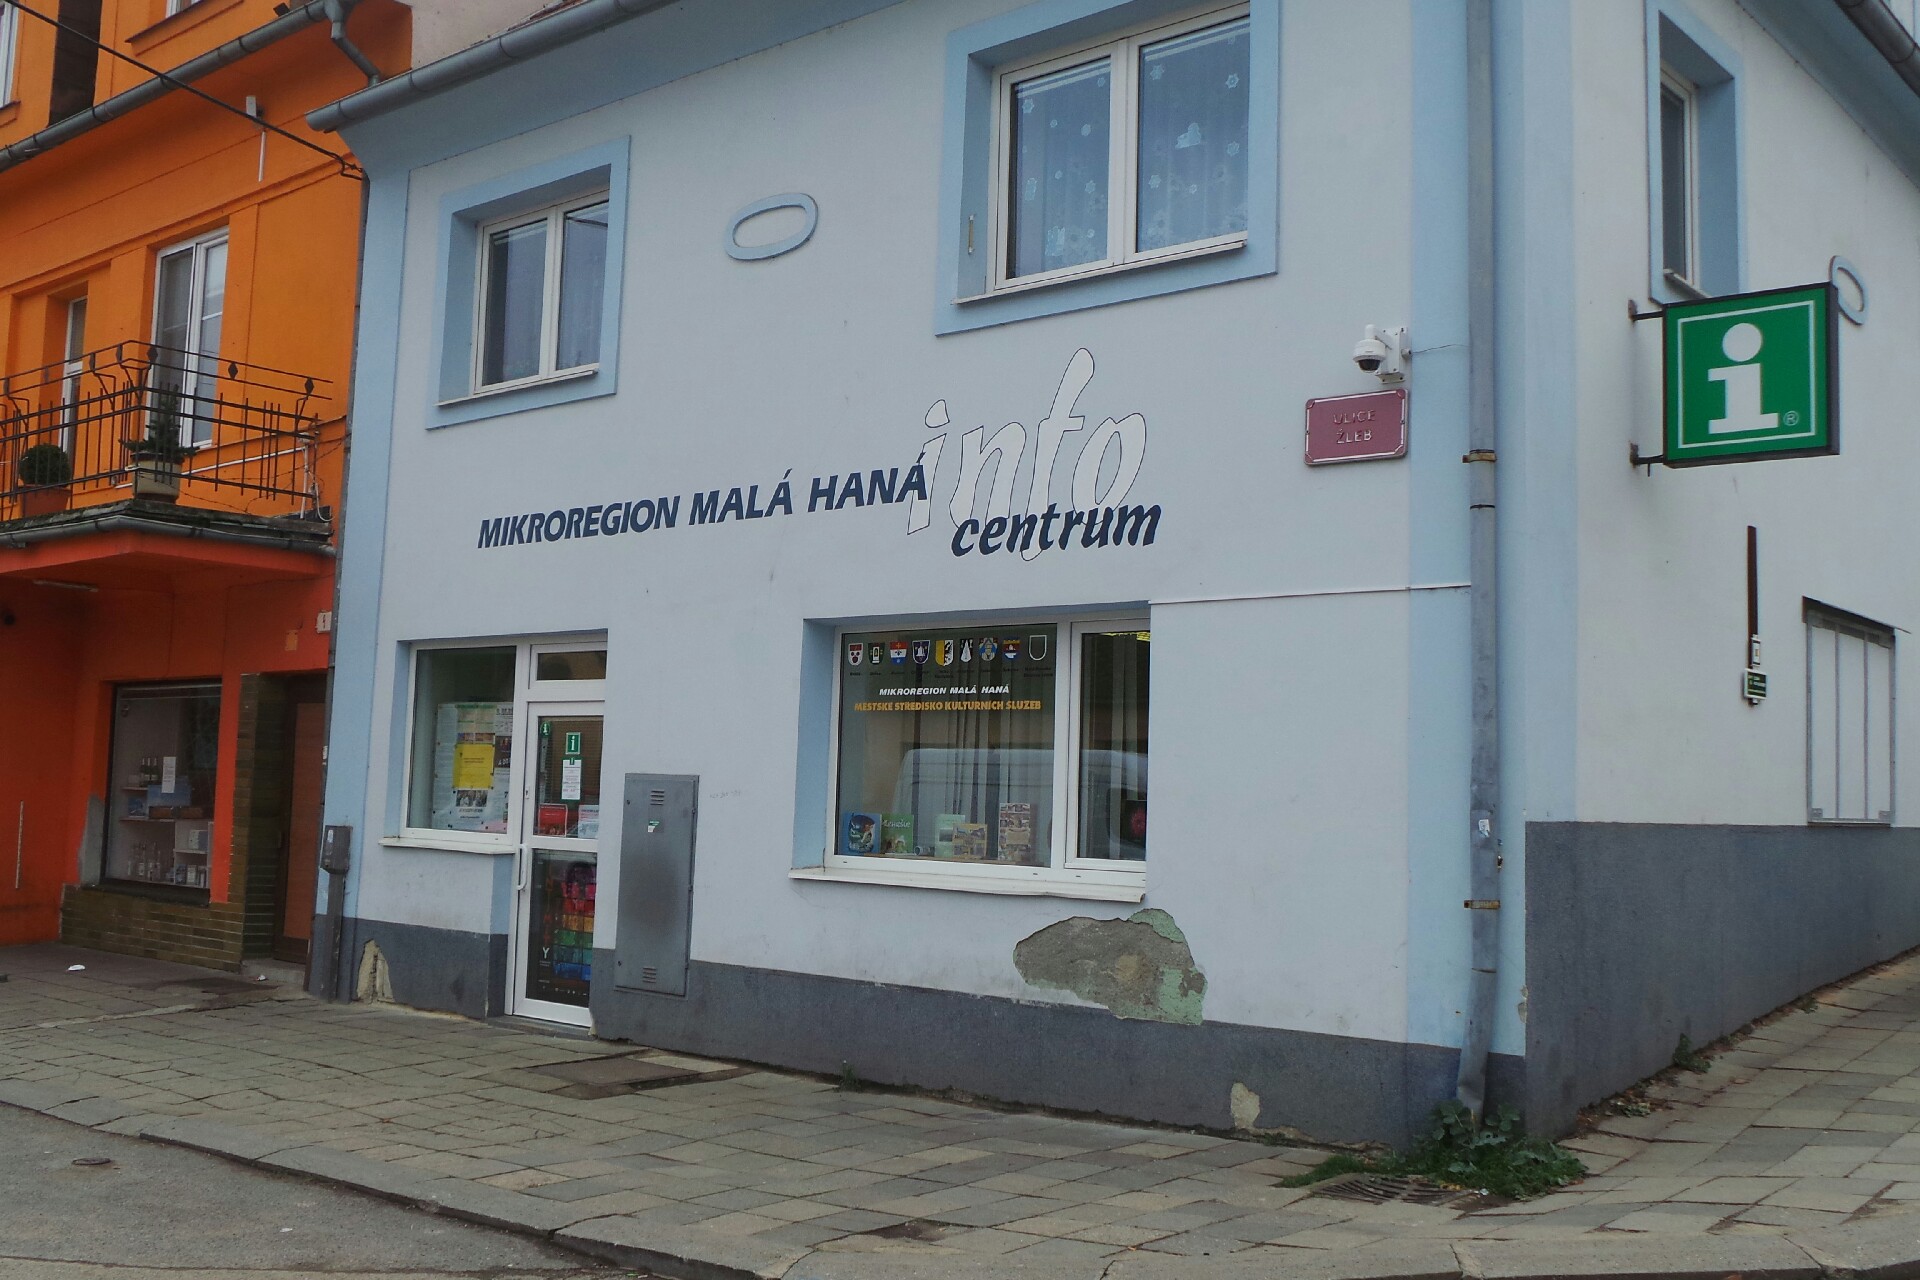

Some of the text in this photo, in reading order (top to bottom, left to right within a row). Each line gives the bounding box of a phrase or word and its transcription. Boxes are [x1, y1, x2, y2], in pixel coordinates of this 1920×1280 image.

[1332, 409, 1377, 424] ULICE
[907, 347, 1147, 562] info
[477, 451, 928, 549] MIKROREGION MALÁ HANÁ
[951, 503, 1162, 557] centrum
[879, 684, 1010, 696] MIKROREGION MALÁ HANÁ
